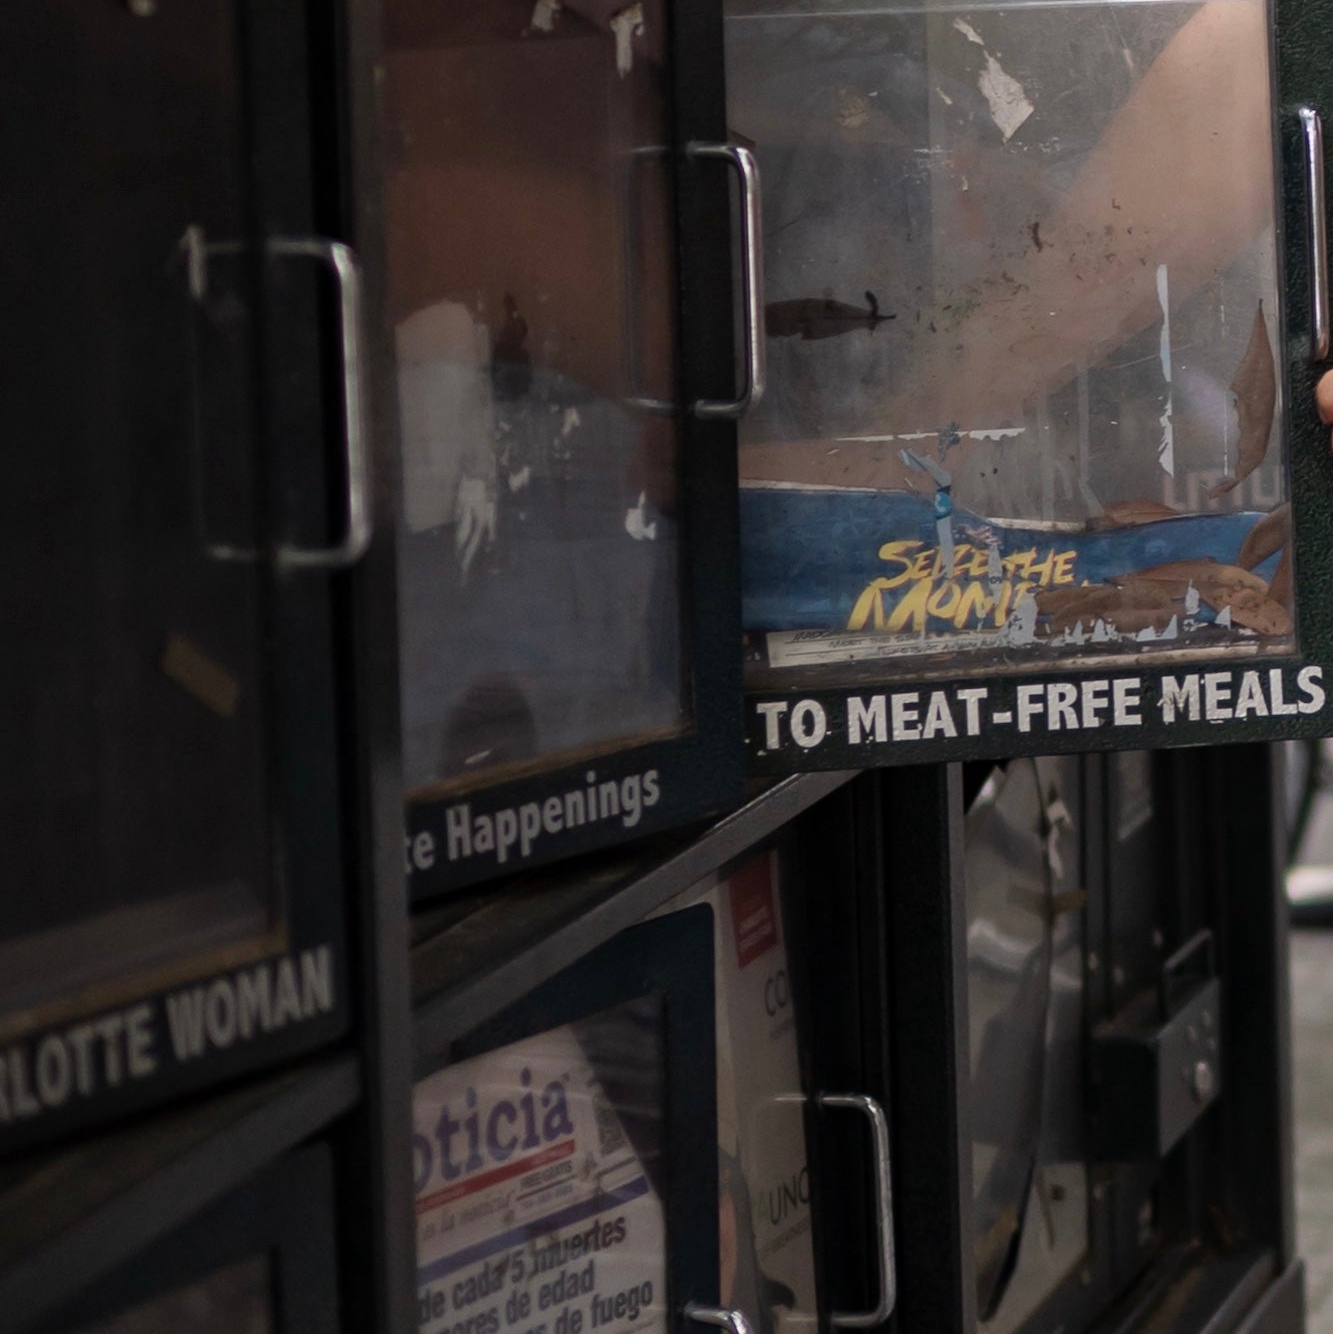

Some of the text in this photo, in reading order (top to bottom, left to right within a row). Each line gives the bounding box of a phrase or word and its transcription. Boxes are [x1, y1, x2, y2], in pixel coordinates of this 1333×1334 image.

[871, 540, 1078, 589] SEIZE THE
[756, 665, 1327, 751] TO MEAT-FREE MEALS
[403, 769, 661, 875] e Happenings
[164, 943, 335, 1062] WOMAN
[452, 1261, 505, 1310] cada
[510, 1249, 527, 1284] 5
[530, 1216, 627, 1278] muertes
[505, 1289, 533, 1327] de
[537, 1258, 596, 1312] edad
[590, 1280, 654, 1329] fuego
